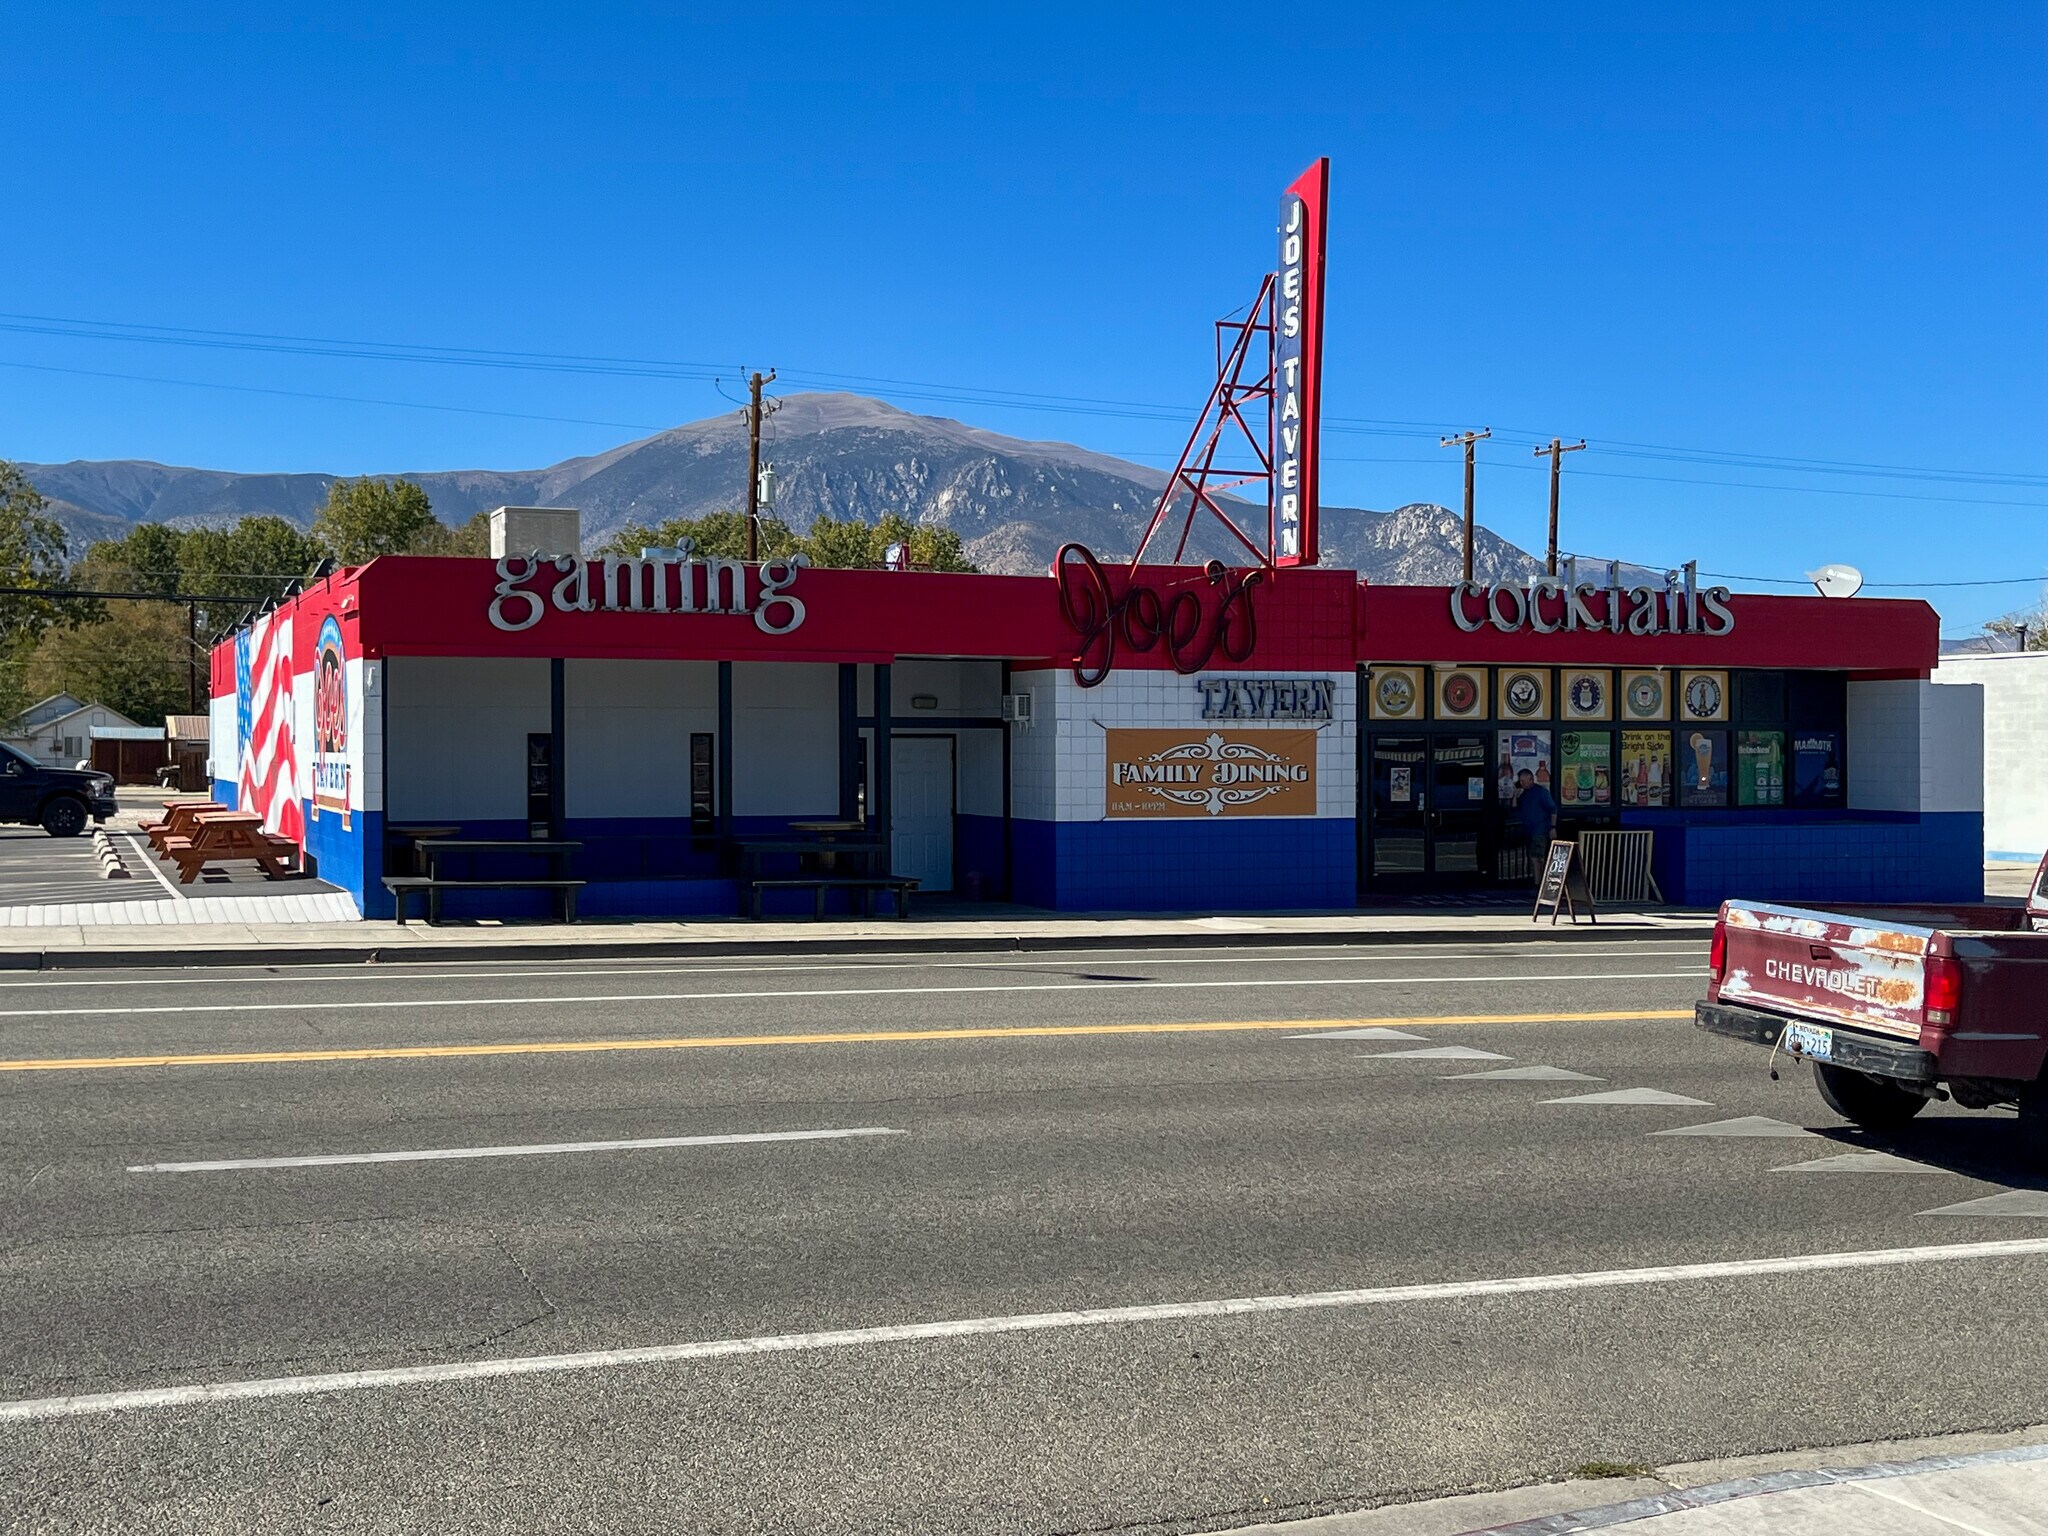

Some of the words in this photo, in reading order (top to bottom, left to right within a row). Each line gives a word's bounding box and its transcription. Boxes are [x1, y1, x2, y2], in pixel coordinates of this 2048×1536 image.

[1281, 200, 1301, 338] JOE'S
[1279, 359, 1301, 556] TAVERN
[488, 536, 810, 635] gaming
[1450, 556, 1736, 636] cocktails
[1198, 679, 1336, 720] TAVERN
[1621, 732, 1642, 741] Drink
[1644, 733, 1655, 741] on
[1657, 732, 1671, 741] the
[1621, 741, 1645, 753] Bright
[1647, 741, 1665, 750] Side
[1112, 761, 1204, 787] FAMILY
[1212, 761, 1309, 786] DINING
[1765, 959, 1880, 997] CHEVROLET
